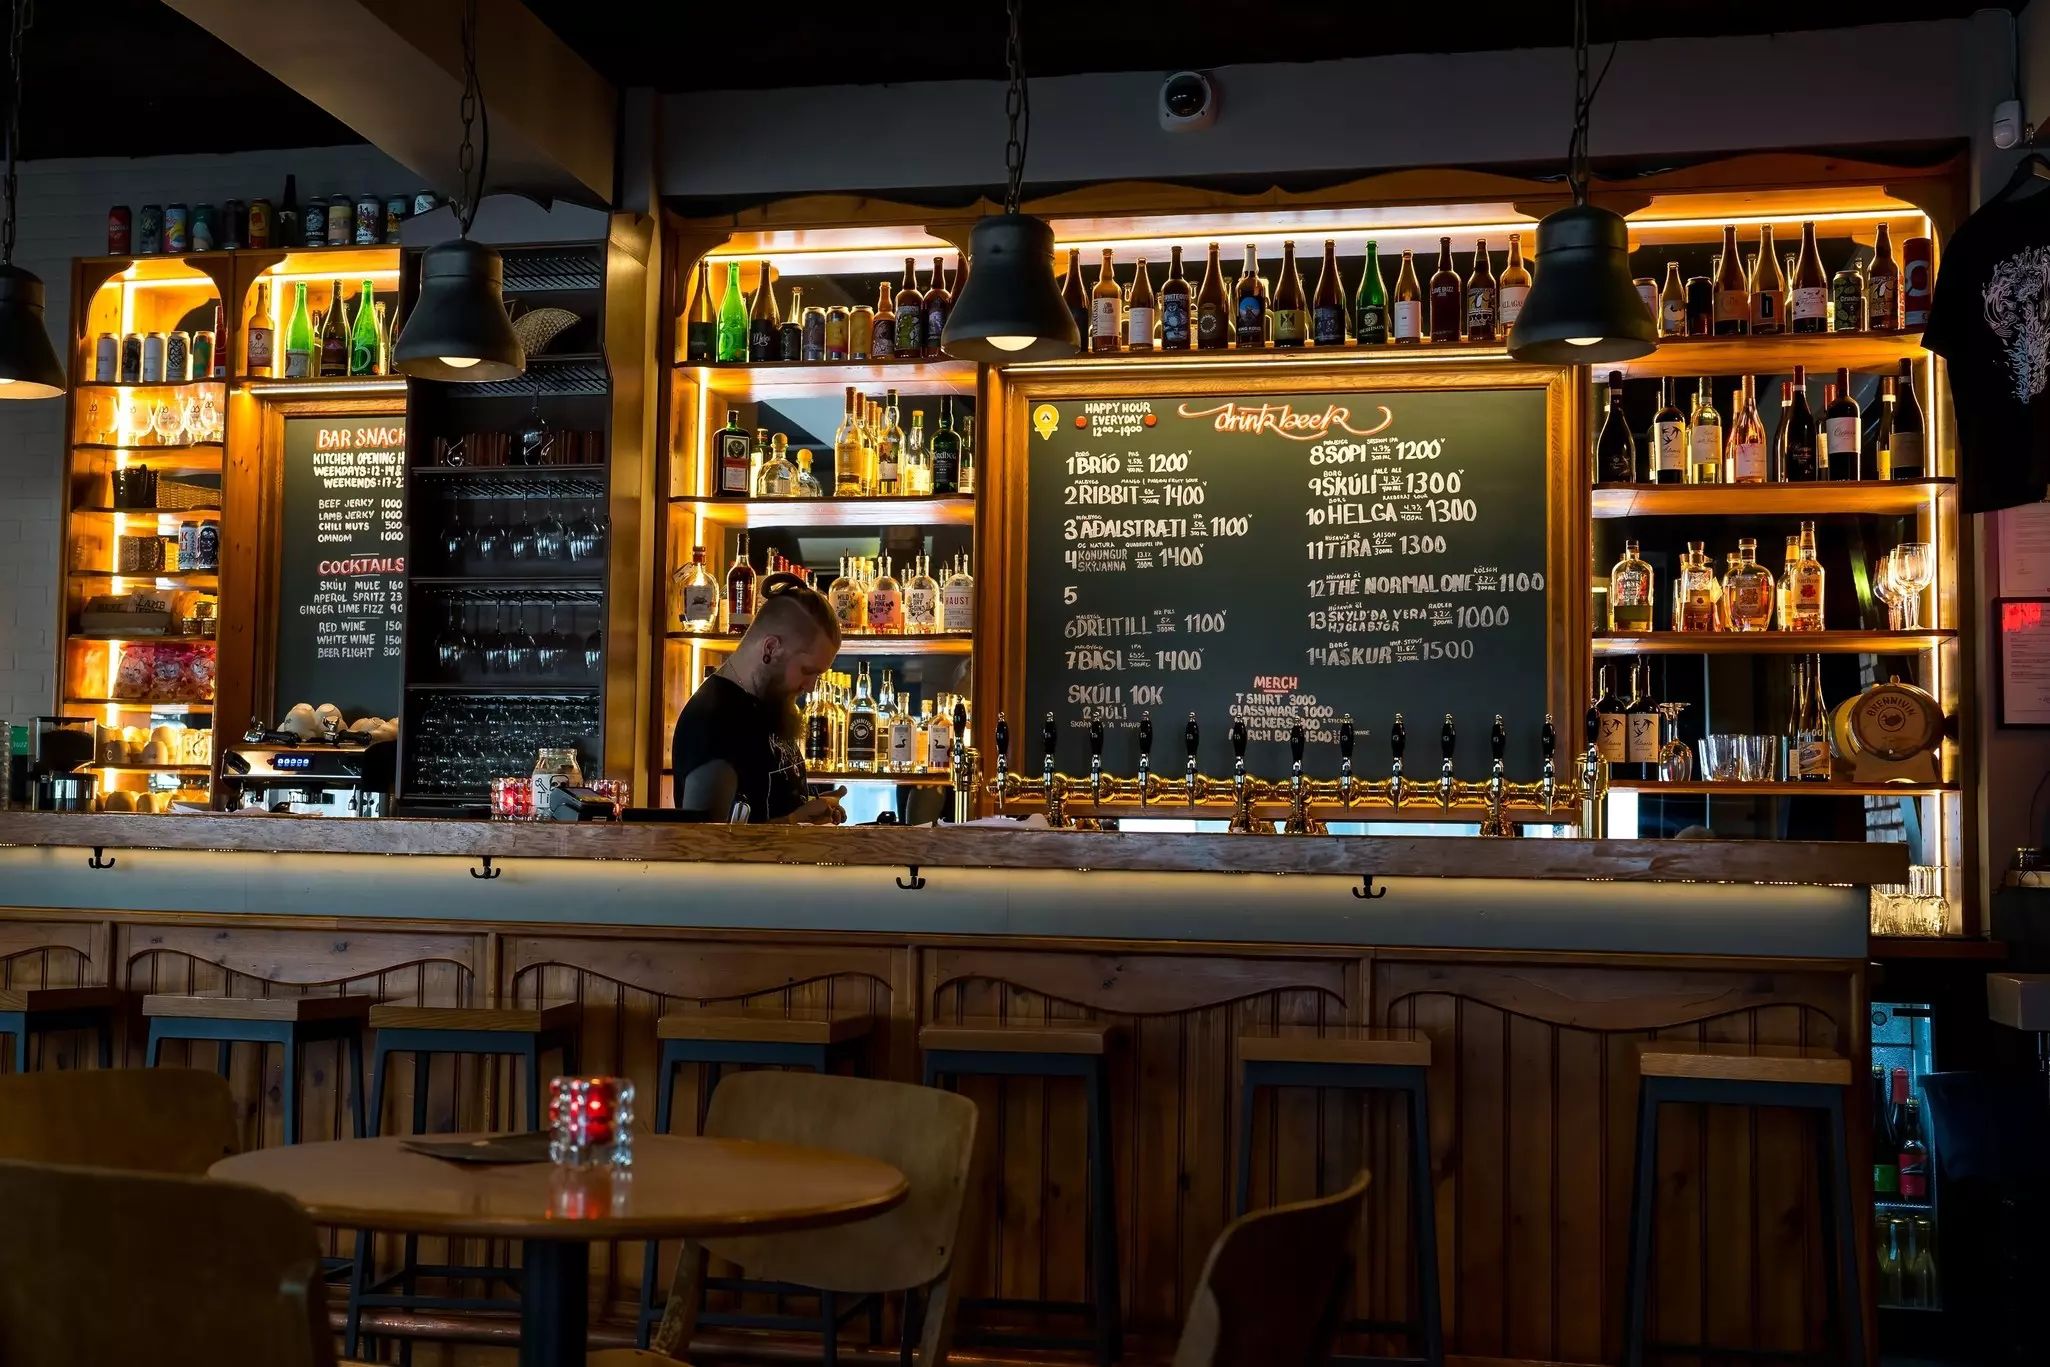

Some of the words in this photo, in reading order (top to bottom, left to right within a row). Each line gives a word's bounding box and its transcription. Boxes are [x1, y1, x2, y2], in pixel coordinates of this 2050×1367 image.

[1085, 402, 1120, 414] HAPPY
[1121, 402, 1151, 413] HOUR
[1092, 414, 1143, 426] EVERYDAY
[317, 428, 352, 450] BAR
[313, 452, 353, 465] KITCHEN
[357, 452, 396, 464] OPENING
[1309, 445, 1325, 465] 8
[1325, 443, 1367, 464] SOPI
[1396, 439, 1442, 460] 1200
[1065, 456, 1075, 475] 1
[1076, 453, 1121, 475] BRÍÓ
[1148, 452, 1189, 473] 1200
[1308, 477, 1321, 496] 9
[1322, 473, 1377, 497] SKÚLI
[1405, 471, 1461, 494] 1300
[318, 499, 341, 509] BEEF
[344, 498, 374, 508] JERKY
[381, 498, 403, 509] 1000
[1064, 486, 1078, 504] 2
[1079, 485, 1140, 505] RIBBIT
[1163, 484, 1205, 507] 1400
[318, 512, 343, 520] LAMB
[345, 510, 375, 520] JERKY
[381, 510, 403, 520] 1000
[1305, 508, 1326, 526] 10
[1328, 502, 1398, 525] HELGA
[1425, 498, 1477, 523] 1300
[318, 522, 342, 531] CHILI
[345, 522, 370, 531] NUTS
[384, 521, 403, 530] 500
[1063, 519, 1078, 540] 3
[1210, 516, 1249, 537] 1100
[317, 533, 352, 543] OMNOM
[380, 531, 404, 541] 1000
[1306, 541, 1323, 560] 11
[1399, 535, 1447, 555] 1300
[318, 557, 405, 575] COCKTAILS
[1065, 550, 1077, 570] 4
[1077, 548, 1128, 561] KONUNGUR
[1158, 547, 1204, 567] 1400
[354, 581, 380, 590] MULE
[1307, 579, 1326, 598] 12
[1326, 578, 1360, 595] THE
[1364, 574, 1439, 595] NORMAL
[1440, 574, 1475, 592] ONE
[1500, 572, 1545, 592] 1100
[313, 593, 348, 603] APEROL
[352, 592, 385, 602] SPRITZ
[1064, 586, 1078, 605] 5
[299, 604, 334, 615] GINGER
[338, 604, 361, 614] LIME
[363, 604, 384, 614] FIZZ
[1307, 611, 1327, 629] 13
[1392, 608, 1427, 620] VERA
[1456, 605, 1510, 629] 1000
[319, 622, 337, 633] RED
[341, 621, 366, 631] WINE
[1064, 619, 1077, 639] 6
[1076, 616, 1153, 639] DREITILL
[1184, 613, 1225, 633] 1100
[316, 635, 348, 645] WHITE
[350, 633, 376, 645] WINE
[317, 648, 340, 658] BEER
[341, 648, 374, 658] FLIGHT
[1064, 651, 1077, 670] 7
[1077, 650, 1127, 671] BASL
[1155, 650, 1202, 671] 1400
[1306, 647, 1327, 666] 14
[1327, 645, 1392, 667] ASKUR
[1422, 640, 1474, 660] 1500
[1253, 676, 1298, 690] MERCH
[1129, 685, 1164, 705] 10K
[1246, 693, 1283, 705] SHIRT
[1289, 694, 1317, 706] 3000
[1303, 705, 1334, 717] 1000
